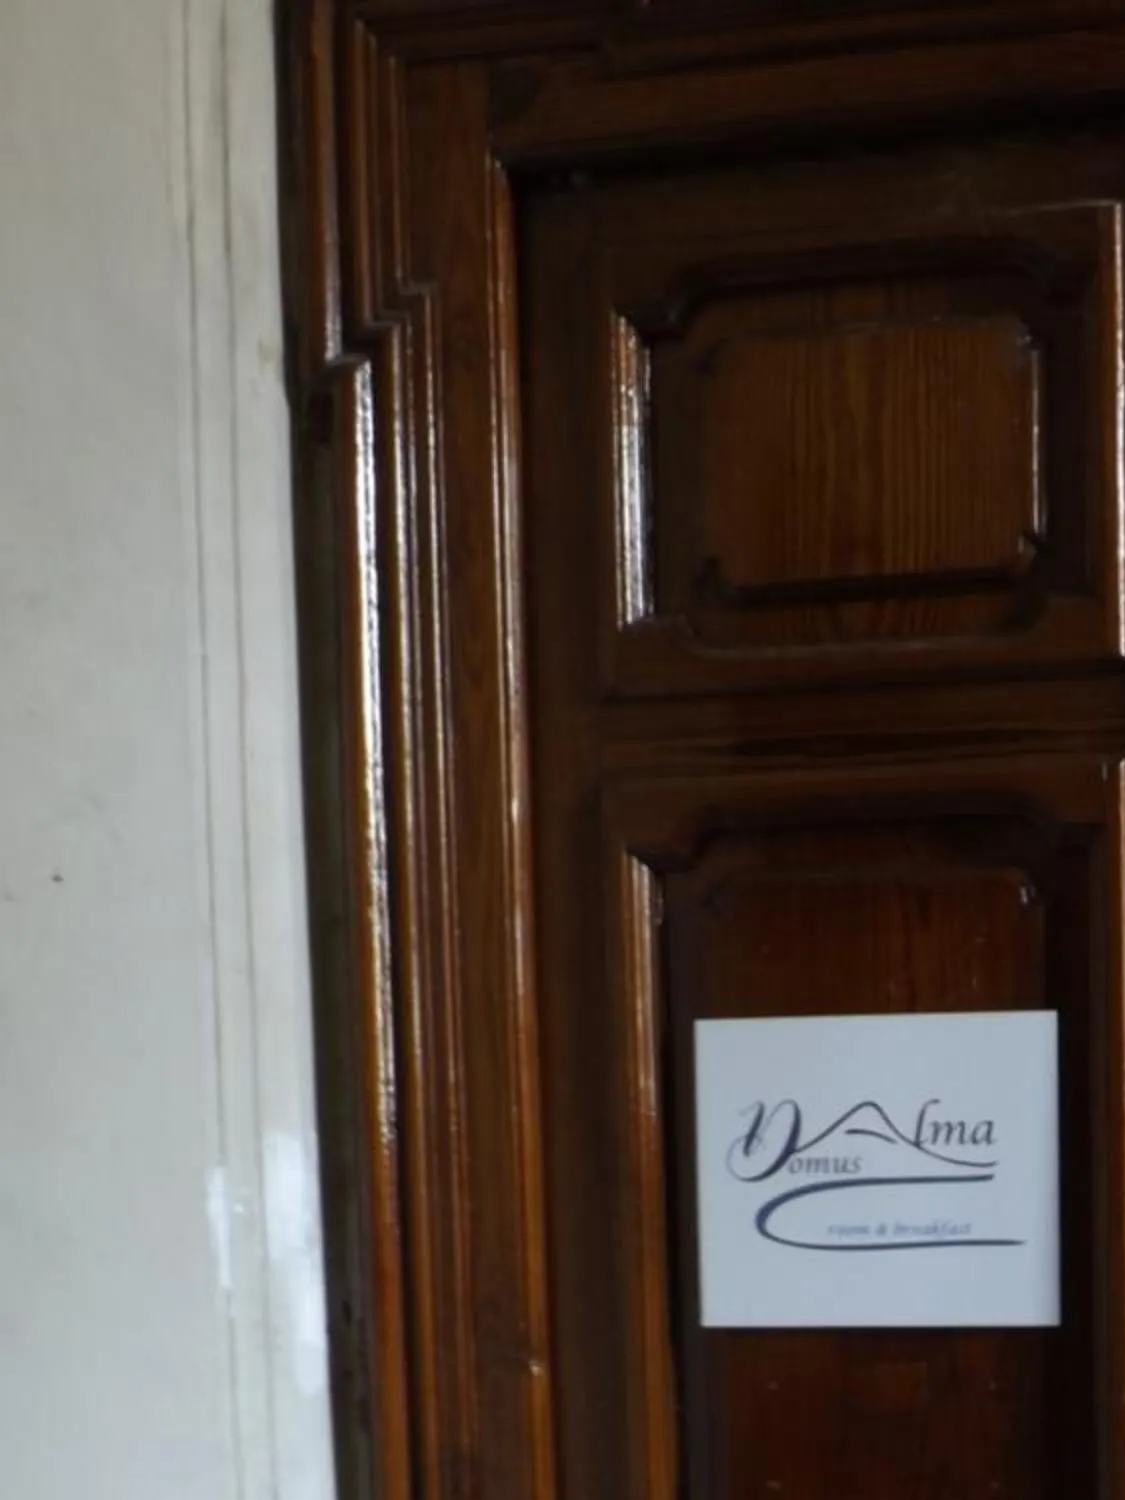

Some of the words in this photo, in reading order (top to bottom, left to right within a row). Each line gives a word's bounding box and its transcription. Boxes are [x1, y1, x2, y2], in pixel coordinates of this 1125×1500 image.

[726, 1098, 863, 1182] Domus
[797, 1098, 998, 1167] Alma
[892, 1218, 973, 1238] breakfast
